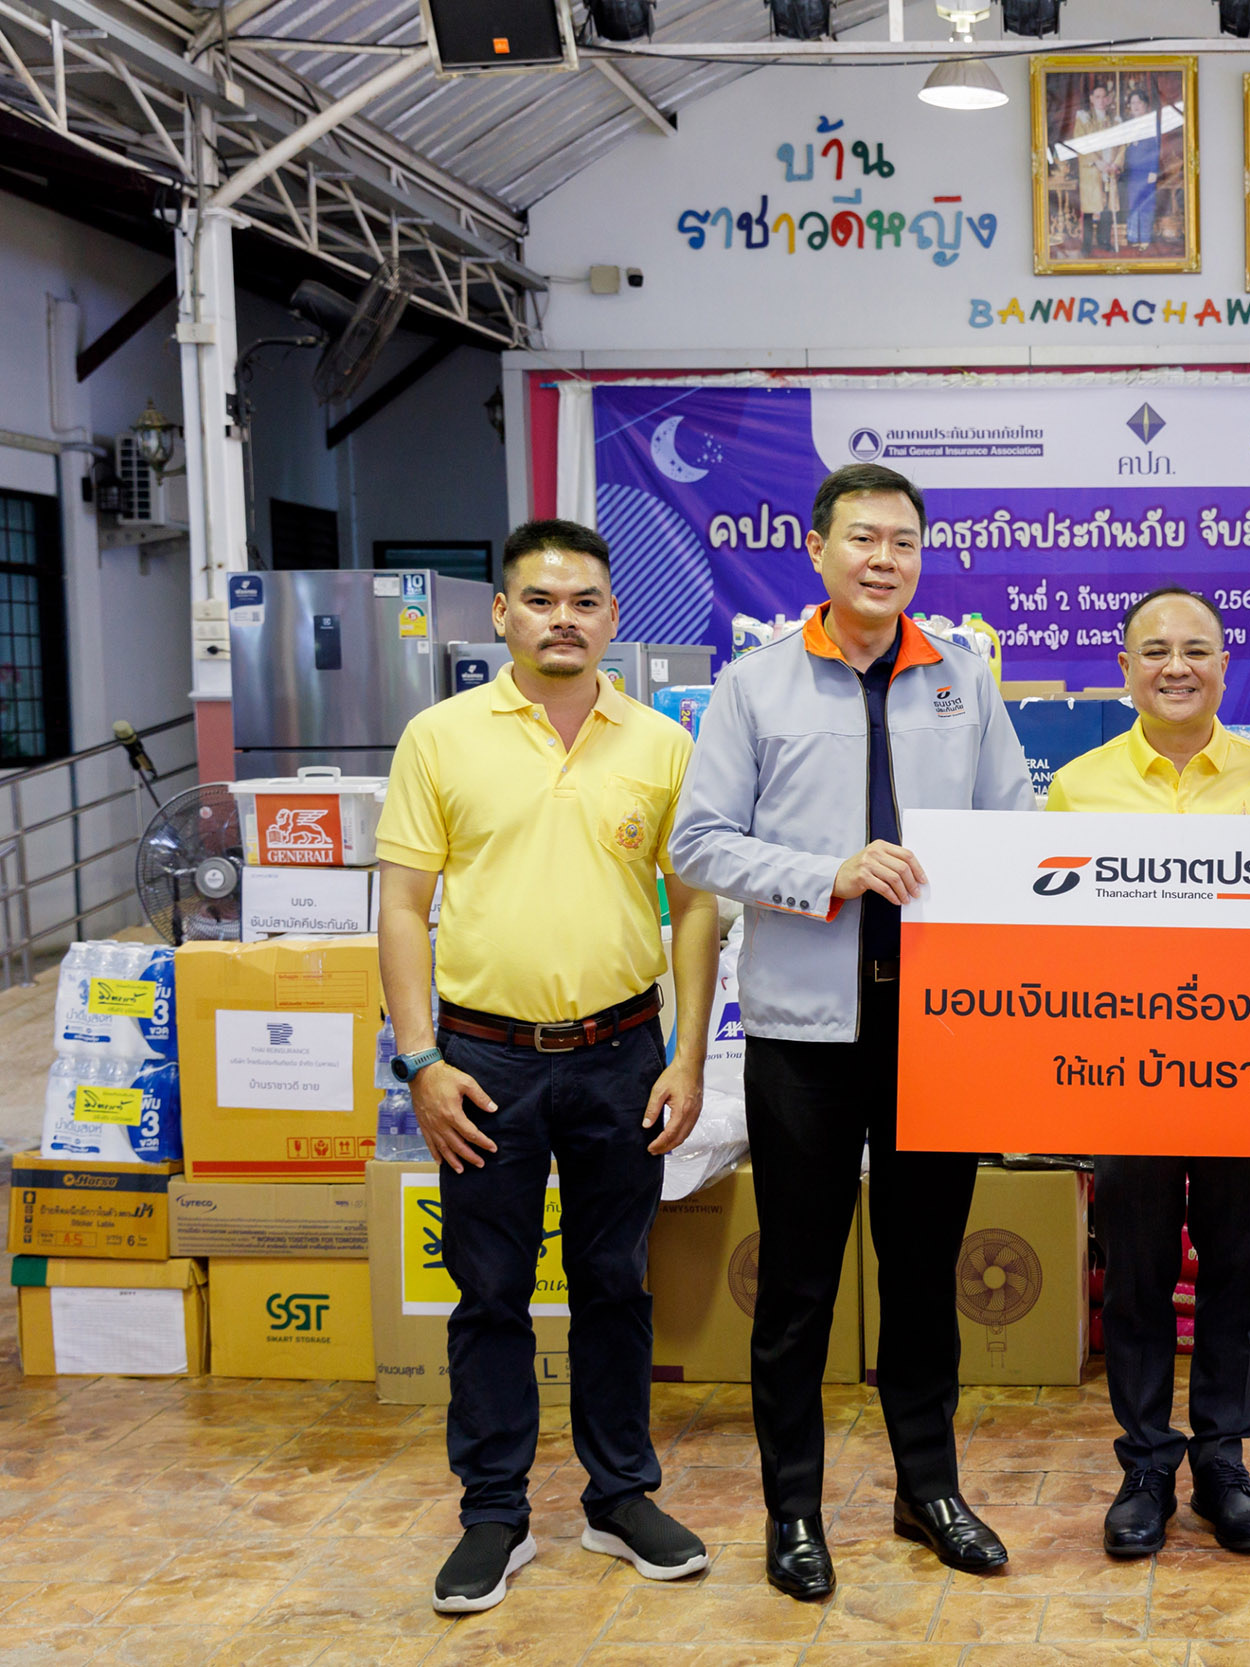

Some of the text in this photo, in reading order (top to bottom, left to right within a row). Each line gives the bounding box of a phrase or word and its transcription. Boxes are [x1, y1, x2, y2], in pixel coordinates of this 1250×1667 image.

[776, 116, 896, 182] บ้าน
[678, 188, 998, 267] ราชาวดีหญิง
[888, 446, 1042, 456] Thai General Insurance Association
[1117, 450, 1176, 476] คปภ.
[1007, 579, 1047, 611] วันที่
[1055, 591, 1071, 611] 2
[1026, 758, 1050, 769] ERAL
[267, 850, 334, 863] GENERALI
[1096, 888, 1214, 899] Thanachart Insurance
[151, 999, 170, 1026] 3
[1053, 1055, 1125, 1088] ให้แก่
[141, 1110, 160, 1138] 3
[181, 1199, 213, 1208] Lyreco
[543, 1357, 558, 1379] L
